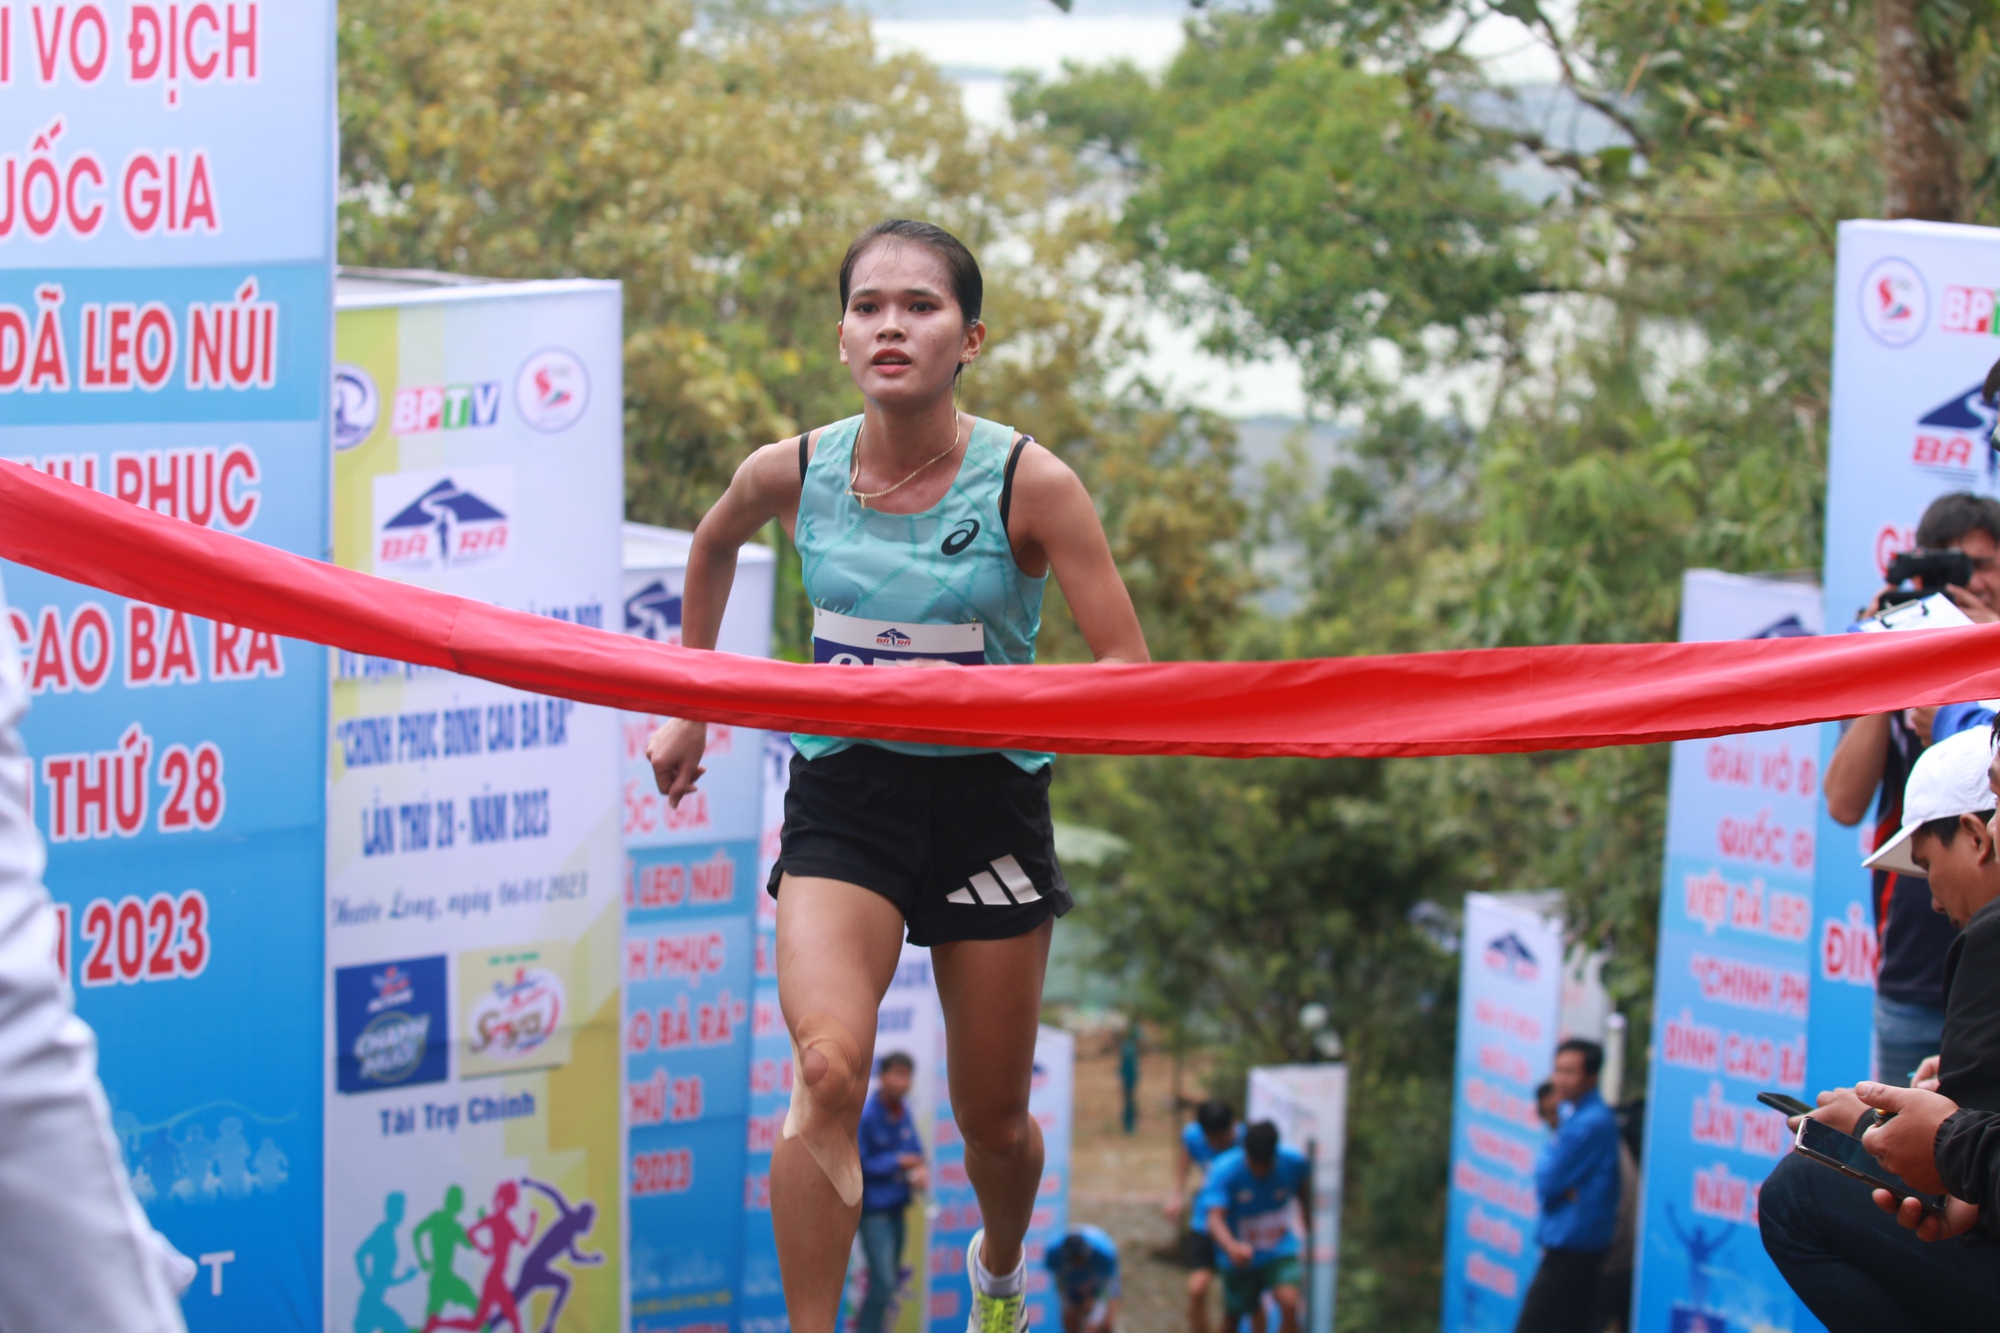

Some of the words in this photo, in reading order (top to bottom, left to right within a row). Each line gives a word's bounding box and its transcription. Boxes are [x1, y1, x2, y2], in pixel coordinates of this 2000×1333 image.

[127, 3, 258, 105] ĐỊCH
[123, 152, 218, 234] GIA
[84, 307, 174, 386] LEO
[190, 284, 274, 385] NÚI
[391, 382, 502, 436] BPTV
[48, 727, 150, 834] THỨ
[161, 744, 222, 828] 28
[85, 895, 206, 983] 2023
